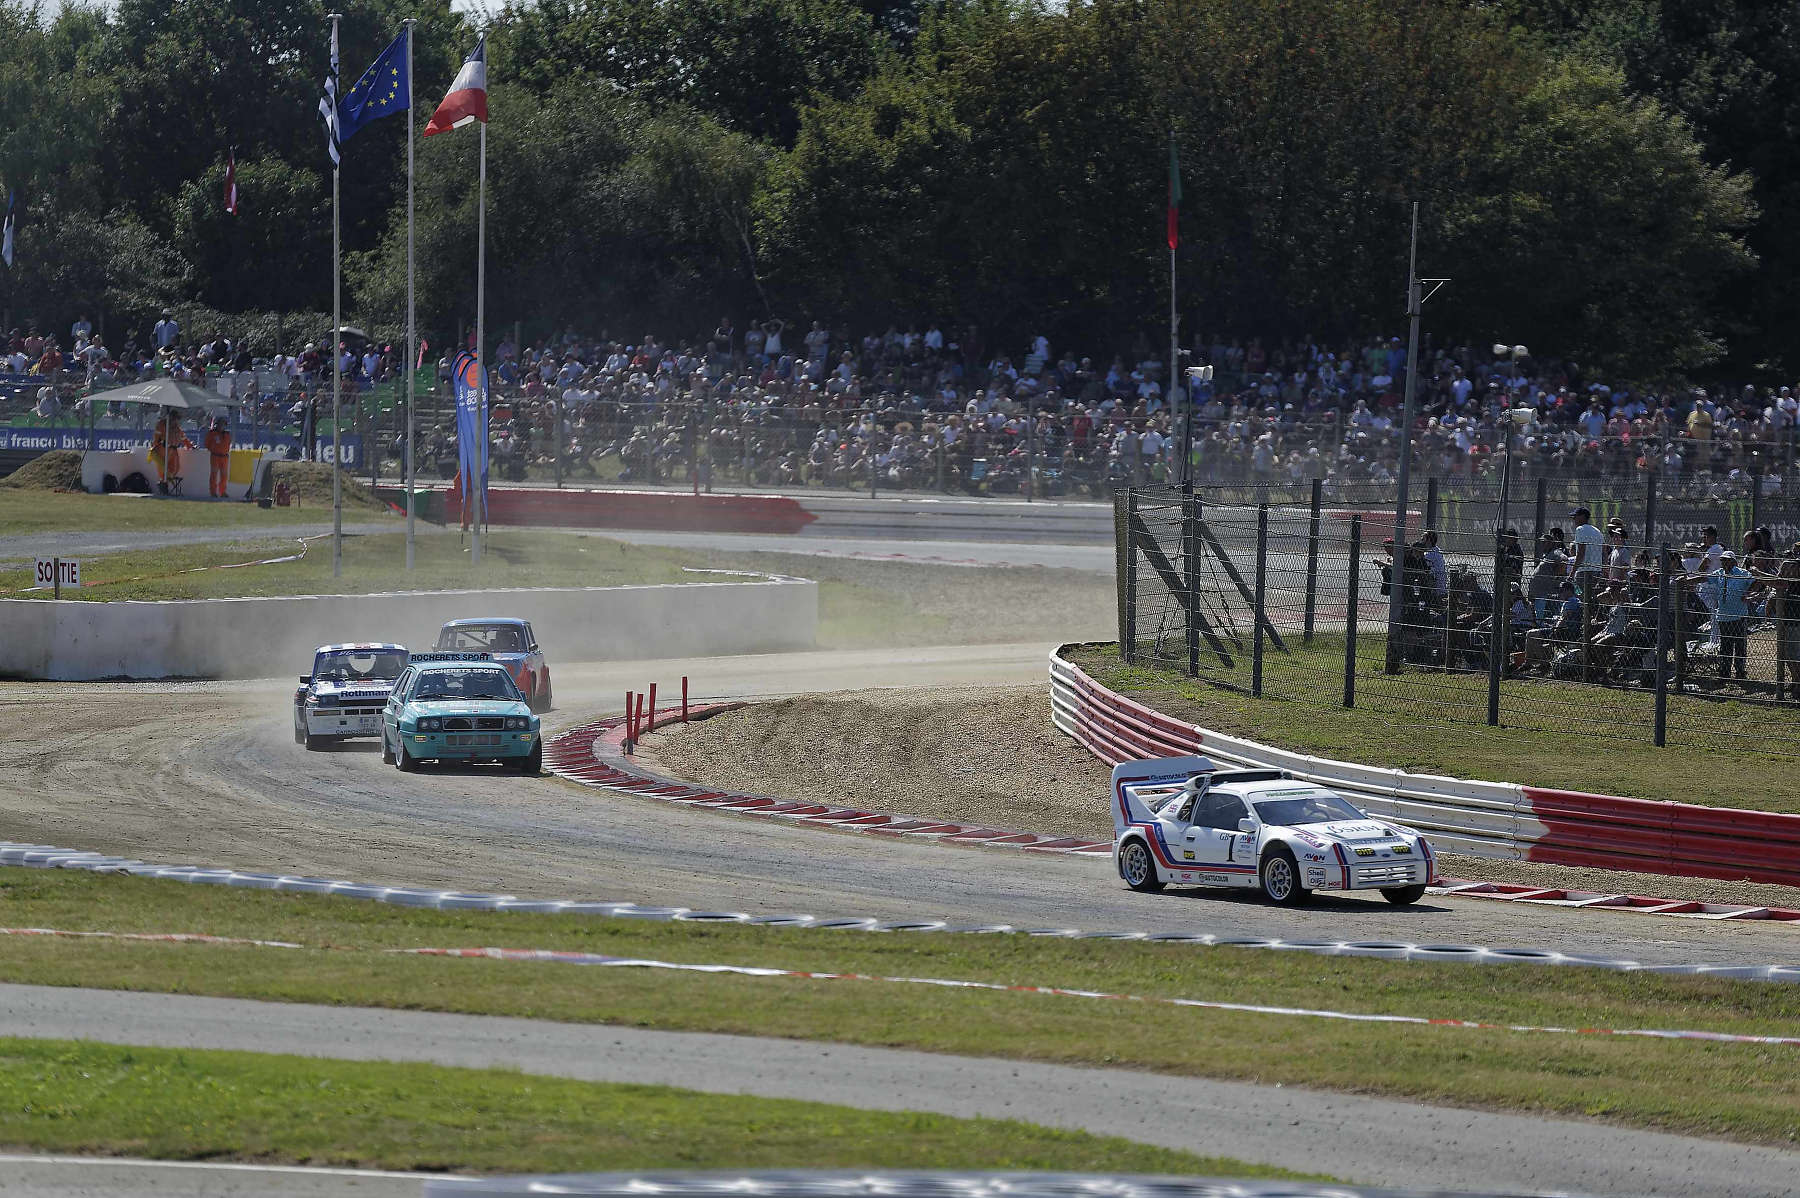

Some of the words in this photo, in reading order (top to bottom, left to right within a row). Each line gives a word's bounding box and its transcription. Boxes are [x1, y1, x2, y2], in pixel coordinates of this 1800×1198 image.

[38, 561, 77, 583] SOTIE
[463, 653, 490, 661] SPORT
[1226, 834, 1237, 862] 1
[1304, 853, 1325, 862] AVON
